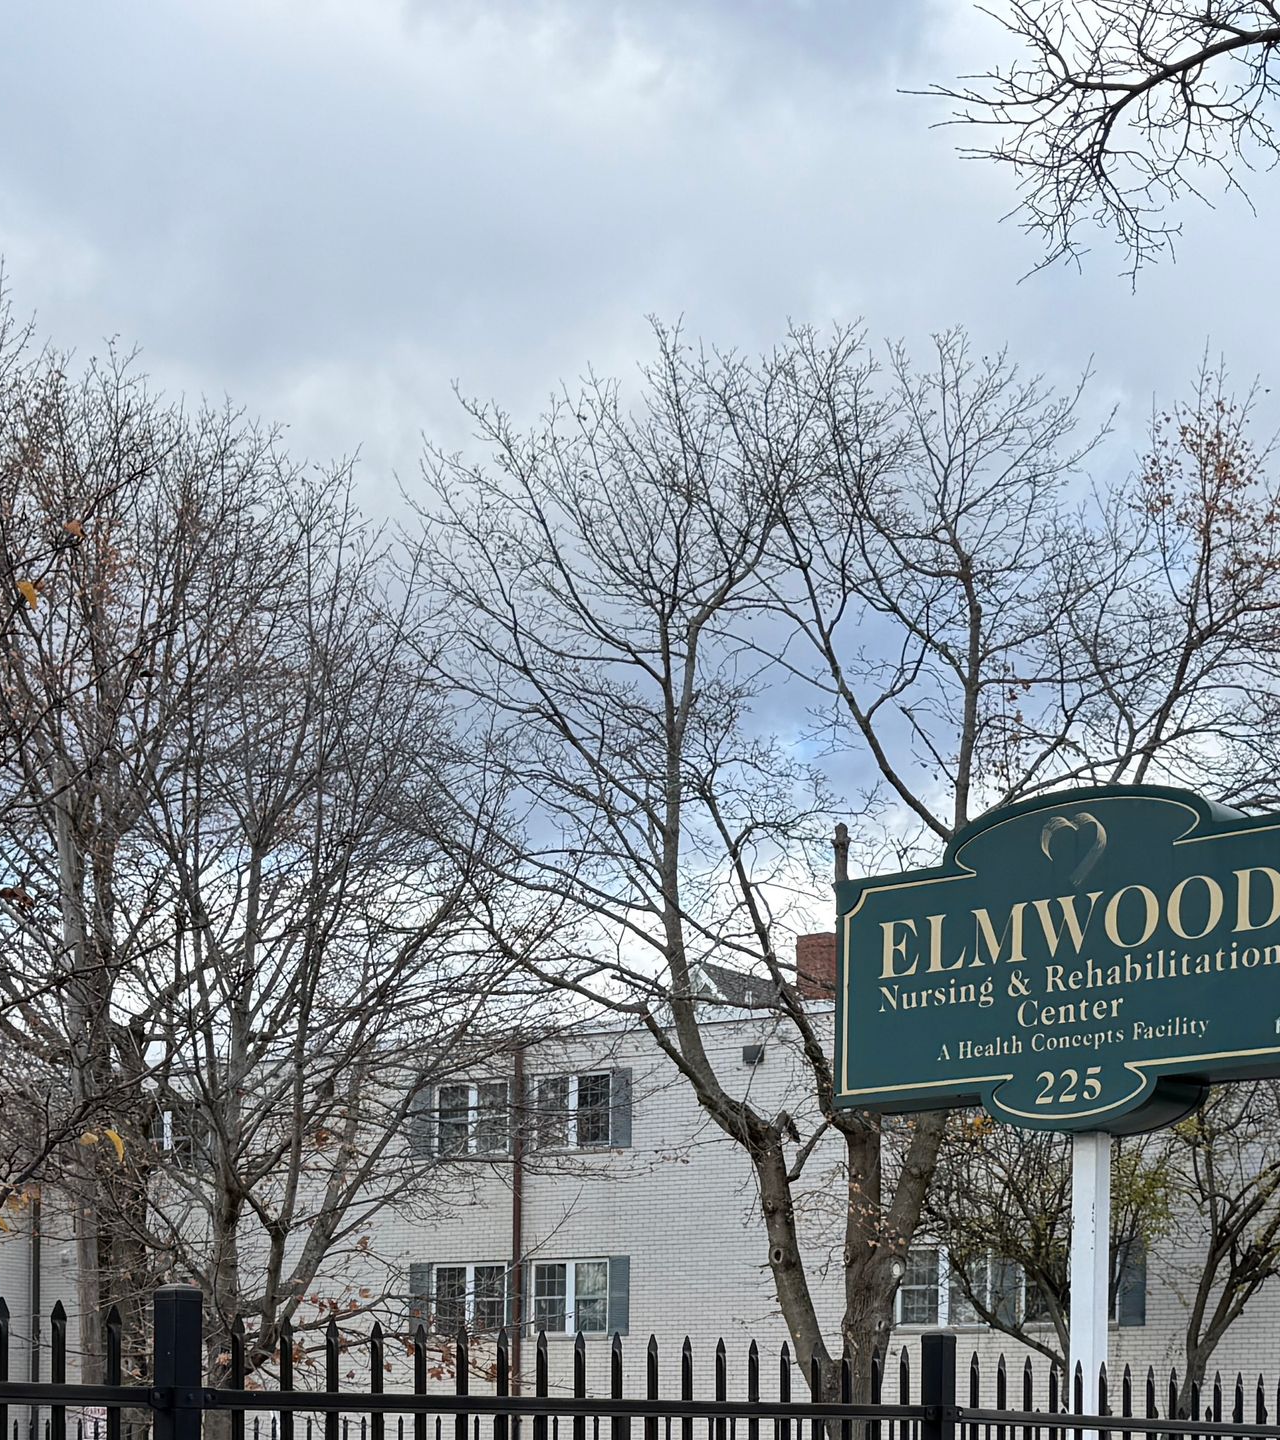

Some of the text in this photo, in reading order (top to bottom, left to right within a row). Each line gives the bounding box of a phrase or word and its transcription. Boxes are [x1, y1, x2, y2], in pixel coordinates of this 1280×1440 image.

[878, 976, 995, 1013] Nursing
[1007, 969, 1032, 997] &
[1017, 997, 1124, 1028] Center
[937, 1016, 1210, 1061] A Health Concepts Facility
[1035, 1066, 1103, 1105] 225
